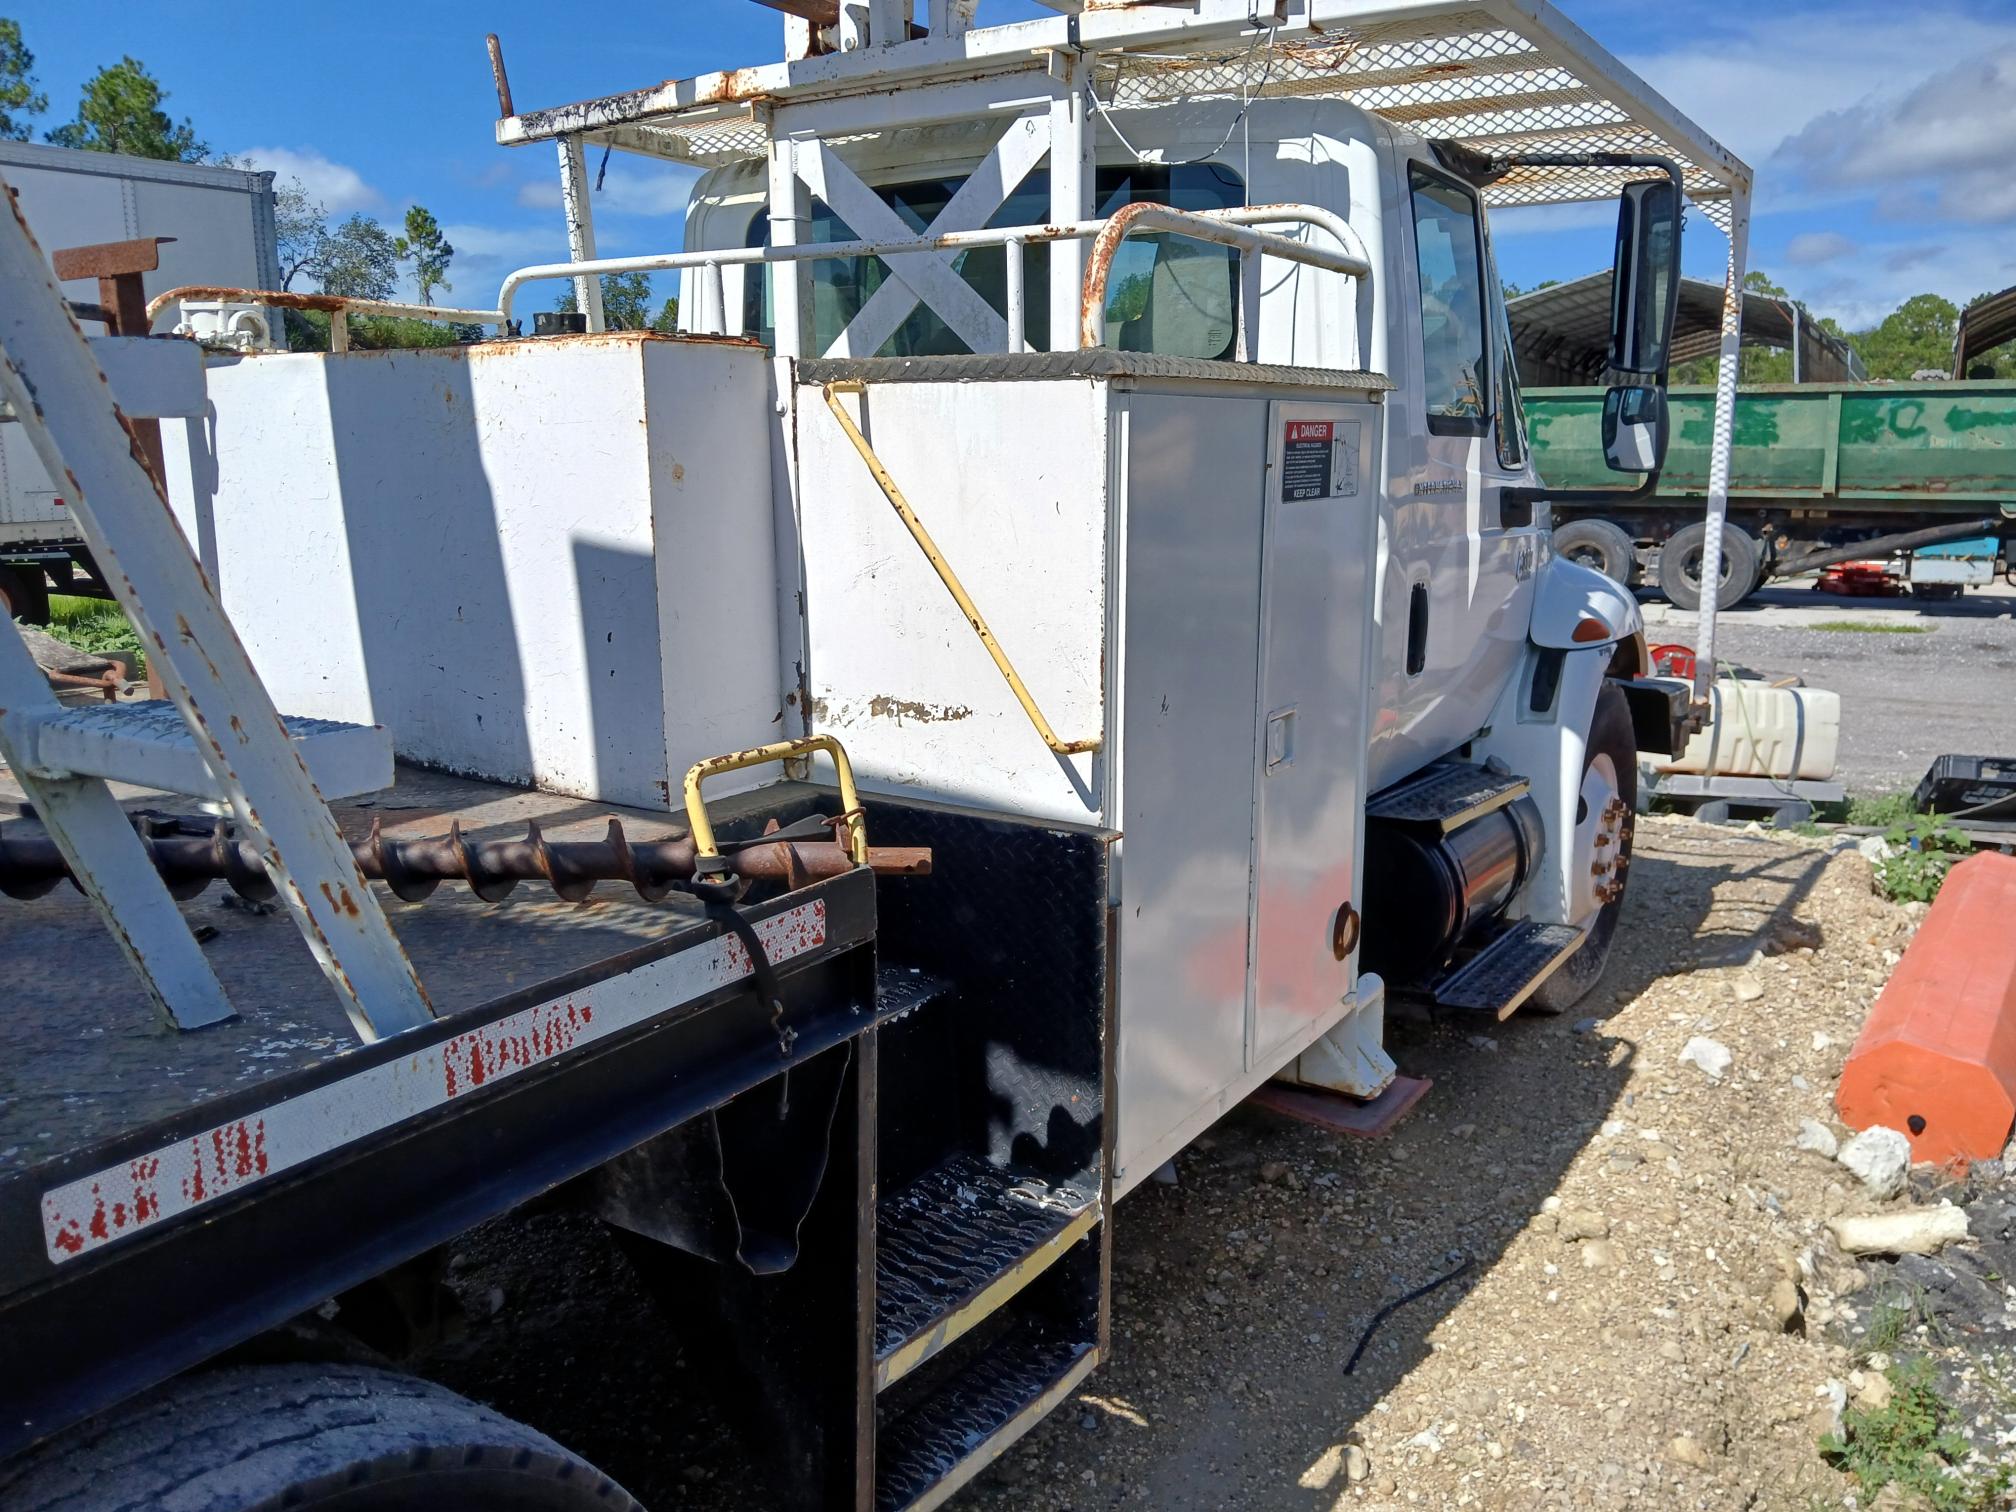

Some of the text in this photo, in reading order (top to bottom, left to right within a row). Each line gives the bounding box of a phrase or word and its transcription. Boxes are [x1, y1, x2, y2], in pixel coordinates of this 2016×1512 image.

[1301, 424, 1327, 437] DANGER
[1294, 488, 1320, 498] KEEP CLEAR
